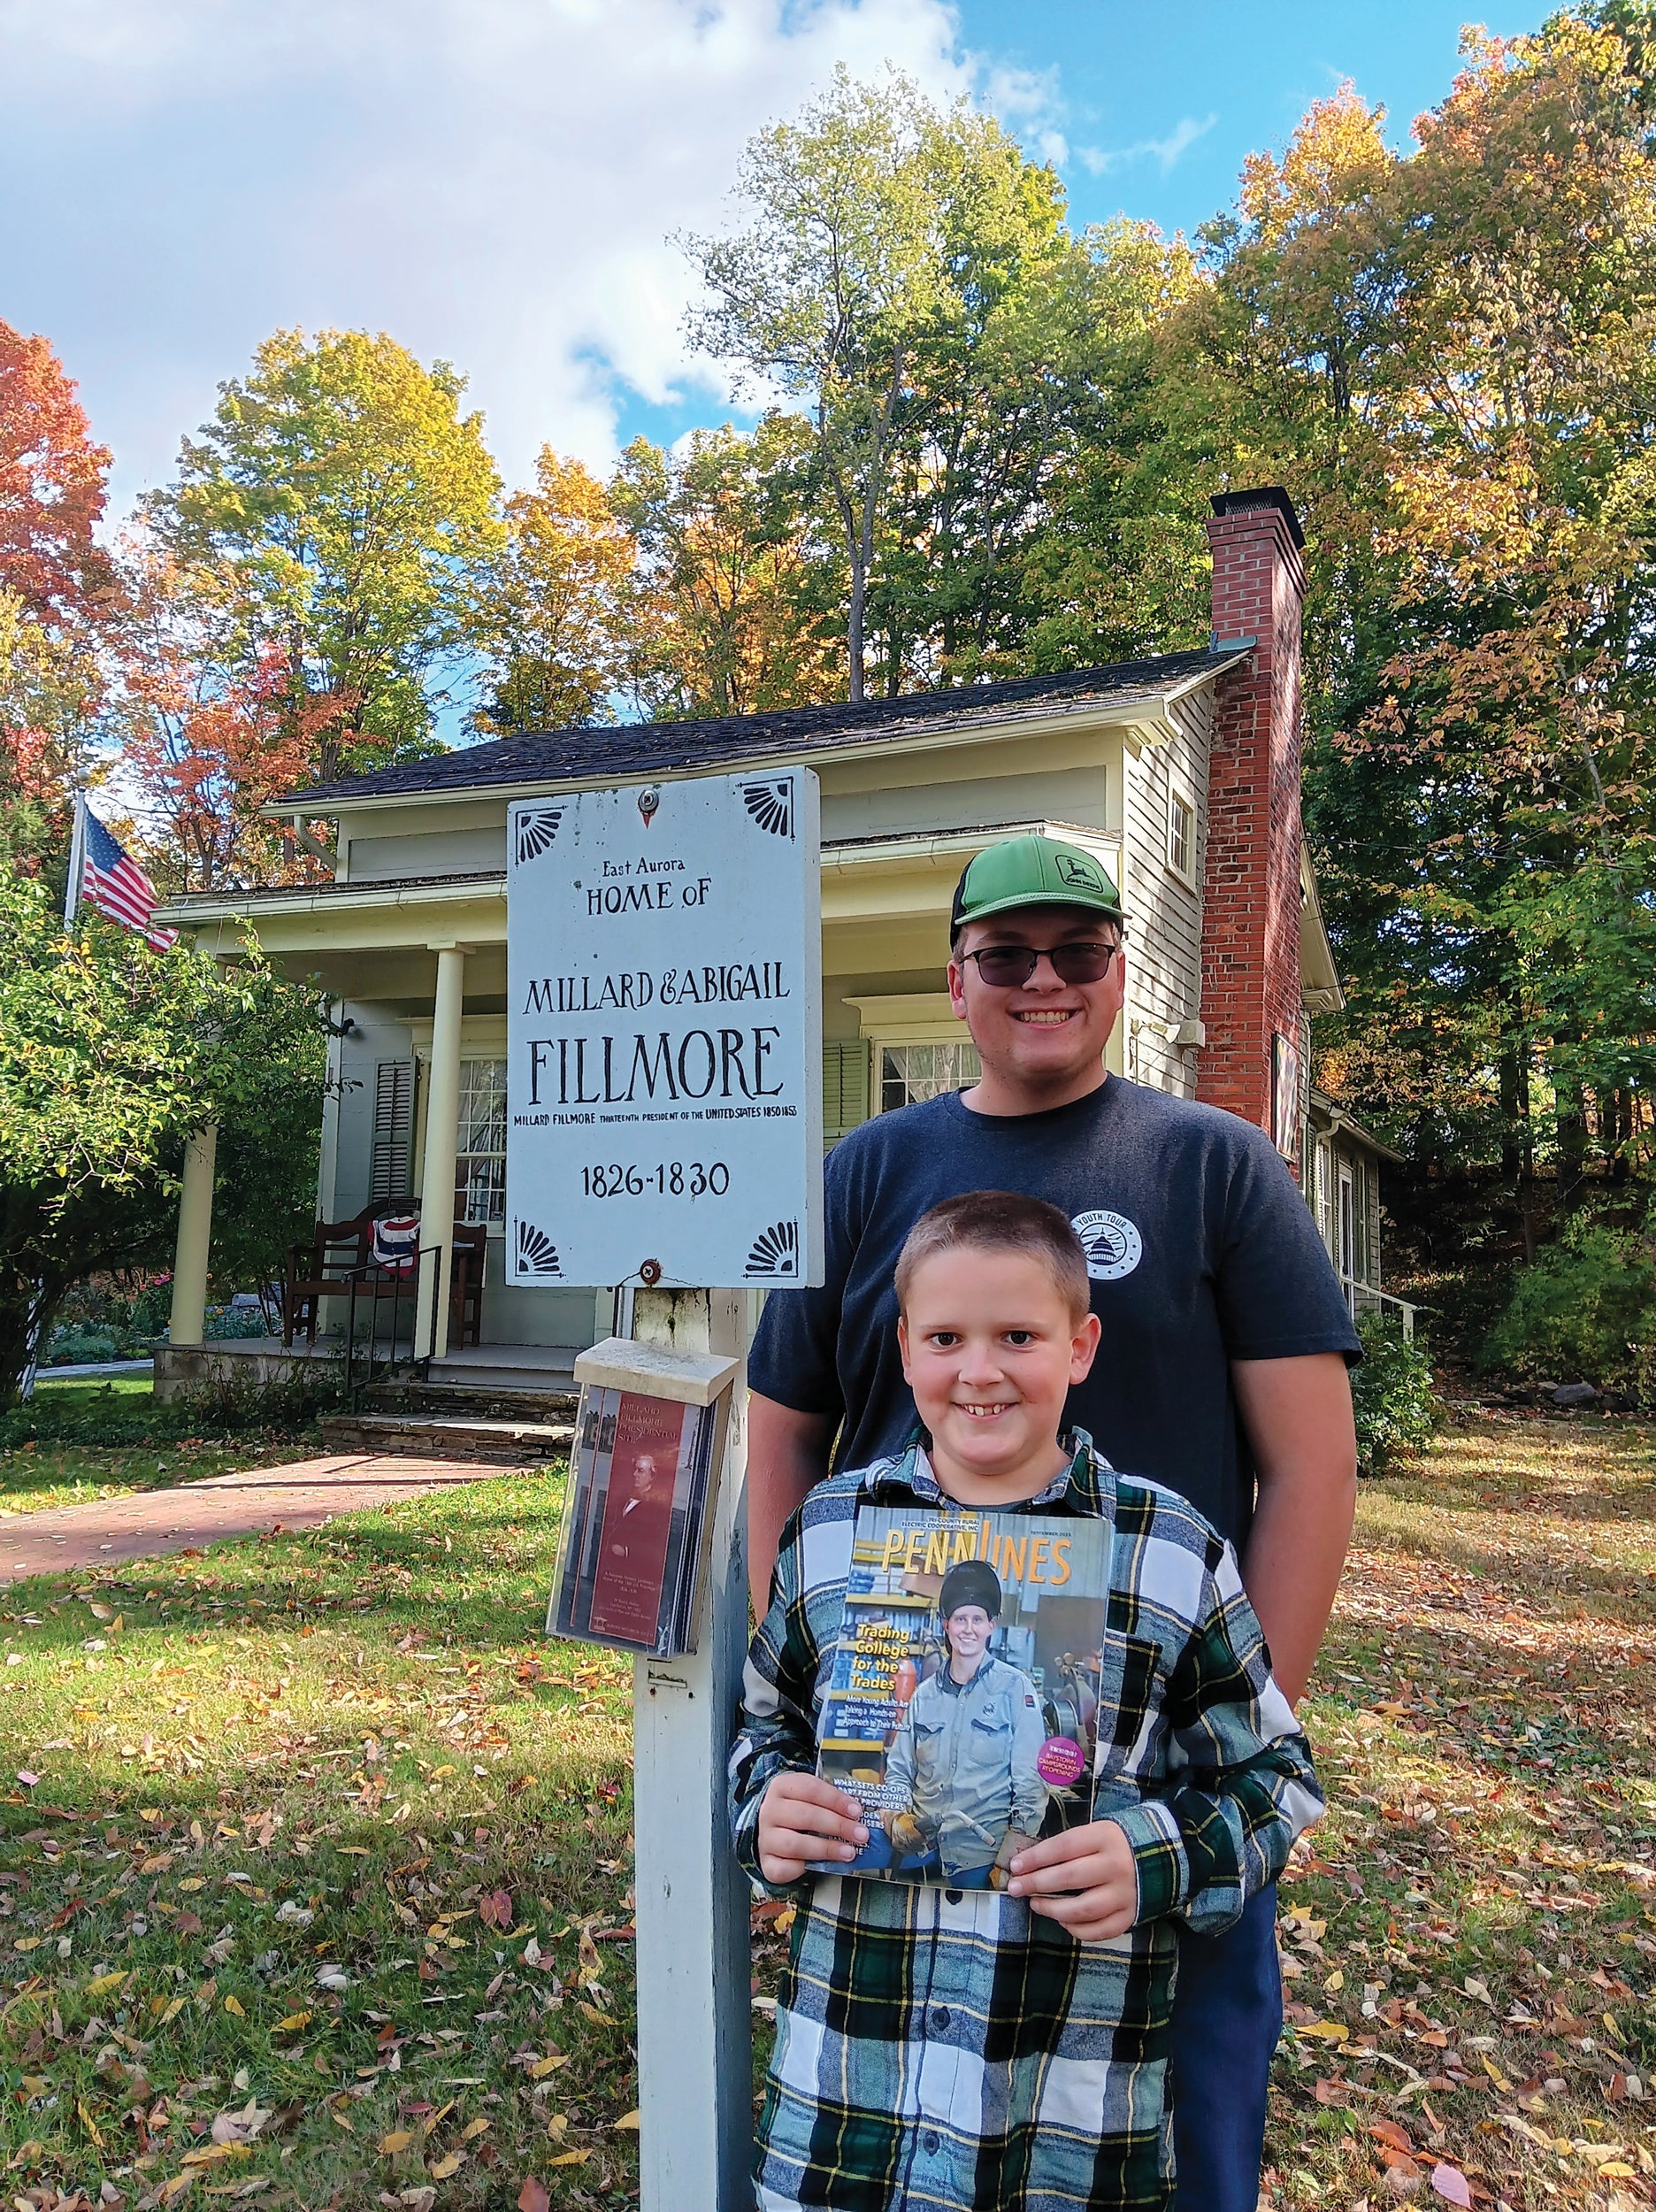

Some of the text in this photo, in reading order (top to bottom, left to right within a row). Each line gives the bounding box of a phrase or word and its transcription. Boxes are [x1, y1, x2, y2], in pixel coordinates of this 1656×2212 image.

[602, 856, 686, 877] East Aurora
[586, 881, 673, 916] HOME
[522, 972, 654, 1015] MILLARD
[526, 1026, 784, 1106] FILLMORE
[514, 1113, 550, 1126] MILLARD
[553, 1112, 596, 1125] FILLMORE
[600, 1113, 640, 1124] THIRTEENTH
[642, 1112, 678, 1122] PRESIDENT
[680, 1111, 690, 1120] OF
[691, 1110, 703, 1120] THE
[580, 1162, 730, 1199] 1826-1830
[1076, 1213, 1127, 1229] YOUTH TOUR
[621, 1402, 661, 1415] MILLARD
[857, 1624, 910, 1644] Trading
[855, 1640, 909, 1660] College
[852, 1655, 899, 1674] for the
[851, 1674, 895, 1691] Trades
[846, 1694, 862, 1703] More
[862, 1696, 880, 1707] Young
[833, 1778, 855, 1787] WHAT
[856, 1780, 876, 1791] SETS
[858, 1789, 881, 1801] FROM
[882, 1793, 908, 1803] OTHER
[861, 1797, 906, 1811] PROVIDERS
